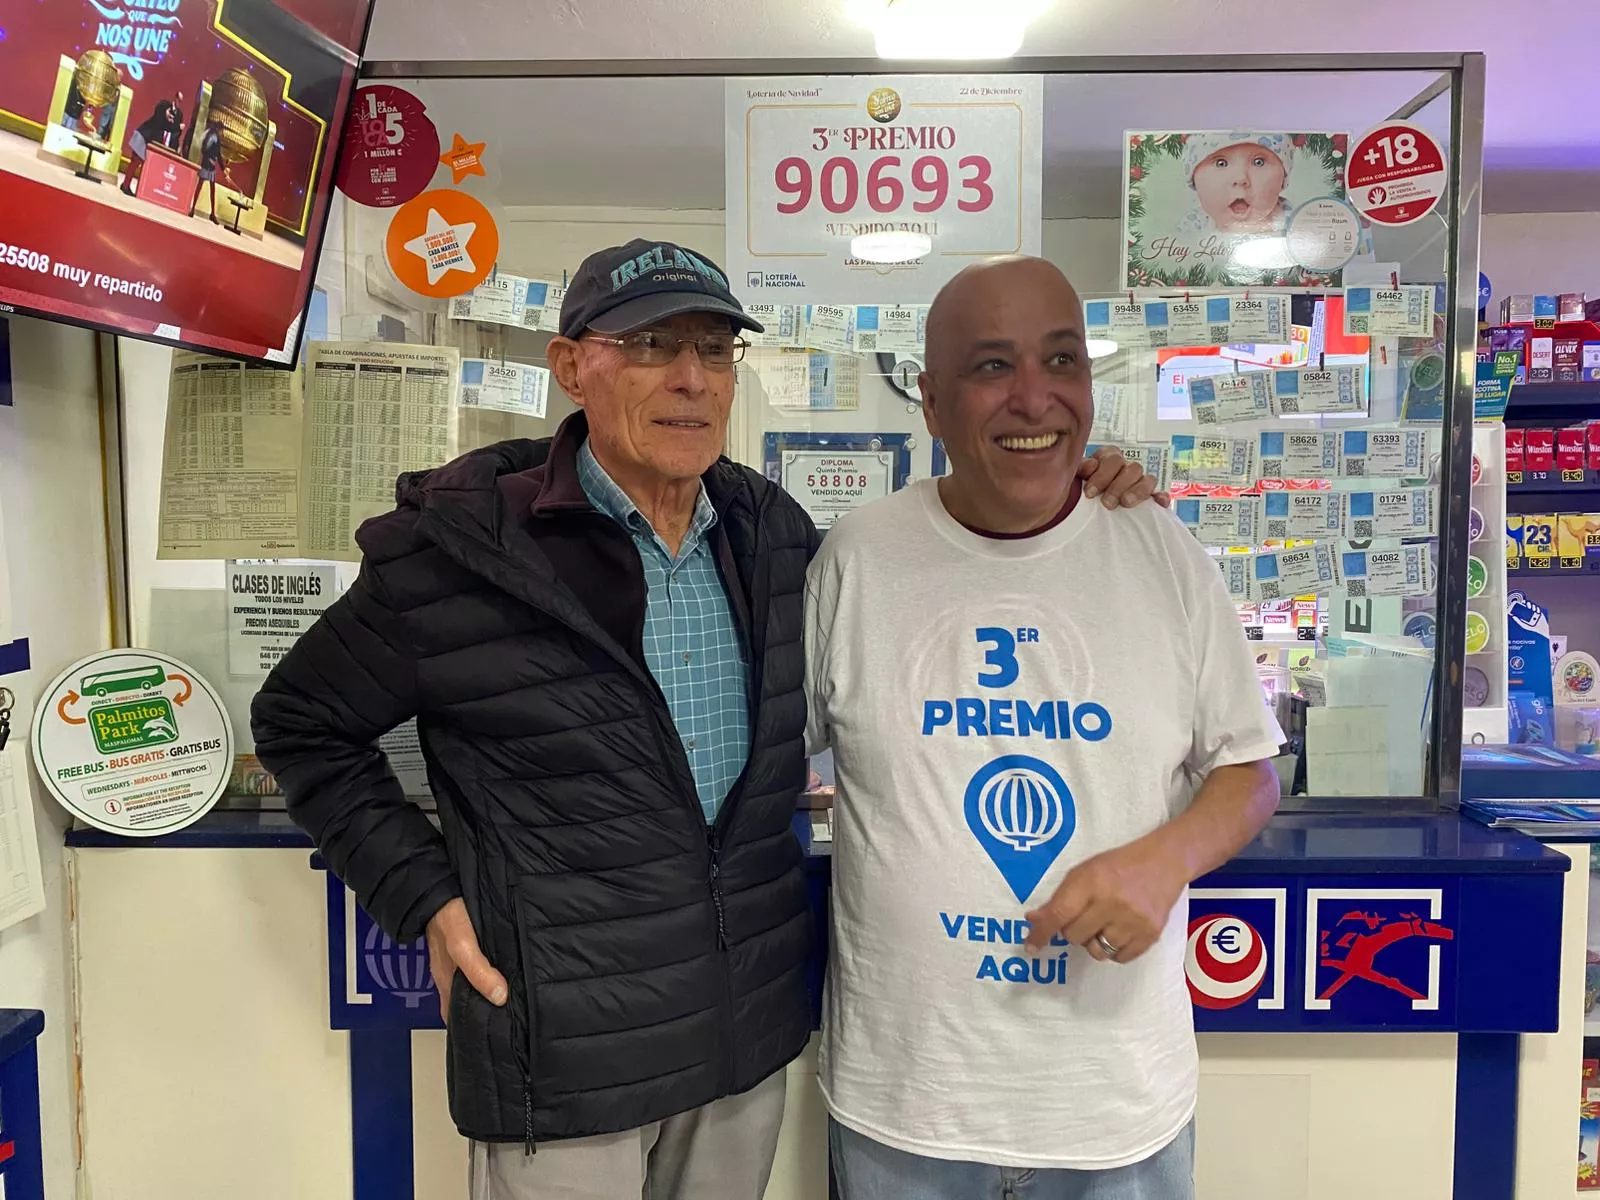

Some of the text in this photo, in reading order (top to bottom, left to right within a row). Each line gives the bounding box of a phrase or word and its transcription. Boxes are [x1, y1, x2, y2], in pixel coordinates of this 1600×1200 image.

[95, 23, 172, 53] NOS UNE
[366, 93, 378, 119] 1
[377, 105, 398, 114] CADA
[385, 112, 405, 145] 5
[843, 126, 956, 151] PREMIO
[1363, 132, 1419, 168] +18
[1387, 163, 1435, 176] RESPONSABILIDAD
[774, 155, 994, 214] 90693
[826, 222, 939, 237] VENDIDO AQUÍ
[428, 242, 459, 257] CADA MARTES
[1141, 237, 1190, 263] Hay
[0, 242, 163, 302] 25508 muy repartido
[609, 245, 728, 292] IRELAND
[652, 272, 697, 283] Original
[765, 273, 798, 281] LOTERÍA
[1376, 291, 1403, 300] 64462
[1115, 304, 1141, 313] 99488
[1173, 304, 1200, 313] 63455
[1235, 300, 1262, 309] 23364
[817, 305, 844, 318] 89595
[884, 310, 911, 319] 14984
[489, 366, 517, 378] 34520
[1303, 372, 1331, 381] 05842
[1290, 435, 1317, 444] 58626
[1373, 434, 1400, 443] 63393
[1200, 440, 1227, 450] 45921
[1528, 445, 1553, 454] Winston
[1558, 444, 1584, 453] Winston
[816, 466, 837, 474] Quinto
[807, 475, 867, 488] 58808
[845, 488, 863, 496] AQUÍ
[1294, 496, 1322, 505] 64172
[1379, 494, 1407, 503] 01794
[1205, 503, 1233, 512] 55722
[1526, 524, 1552, 545] 23
[1282, 552, 1310, 563] 68634
[1371, 553, 1400, 562] 04082
[232, 571, 321, 596] CLASES DE INGLÉS
[254, 595, 304, 604] TODOS LOS NIVELES
[233, 606, 266, 615] EXPERIENCIA
[272, 607, 293, 616] BUENOS
[245, 618, 300, 629] PRECIOS ASEQUIBLES
[91, 690, 163, 706] DIRECT DIRECTO DIREKT
[95, 705, 166, 727] Palmitos
[922, 698, 1113, 742] PREMIO
[99, 721, 141, 740] Park
[104, 736, 144, 748] MASPALOMAS
[57, 738, 221, 780] FREE BUS BUS GRATIS GRATIS BUS
[87, 764, 207, 795] WEDNESDAYS MIÉRCOLES MITTWOCHS
[939, 911, 1069, 947] VEND
[975, 951, 1069, 985] AQUÍ
